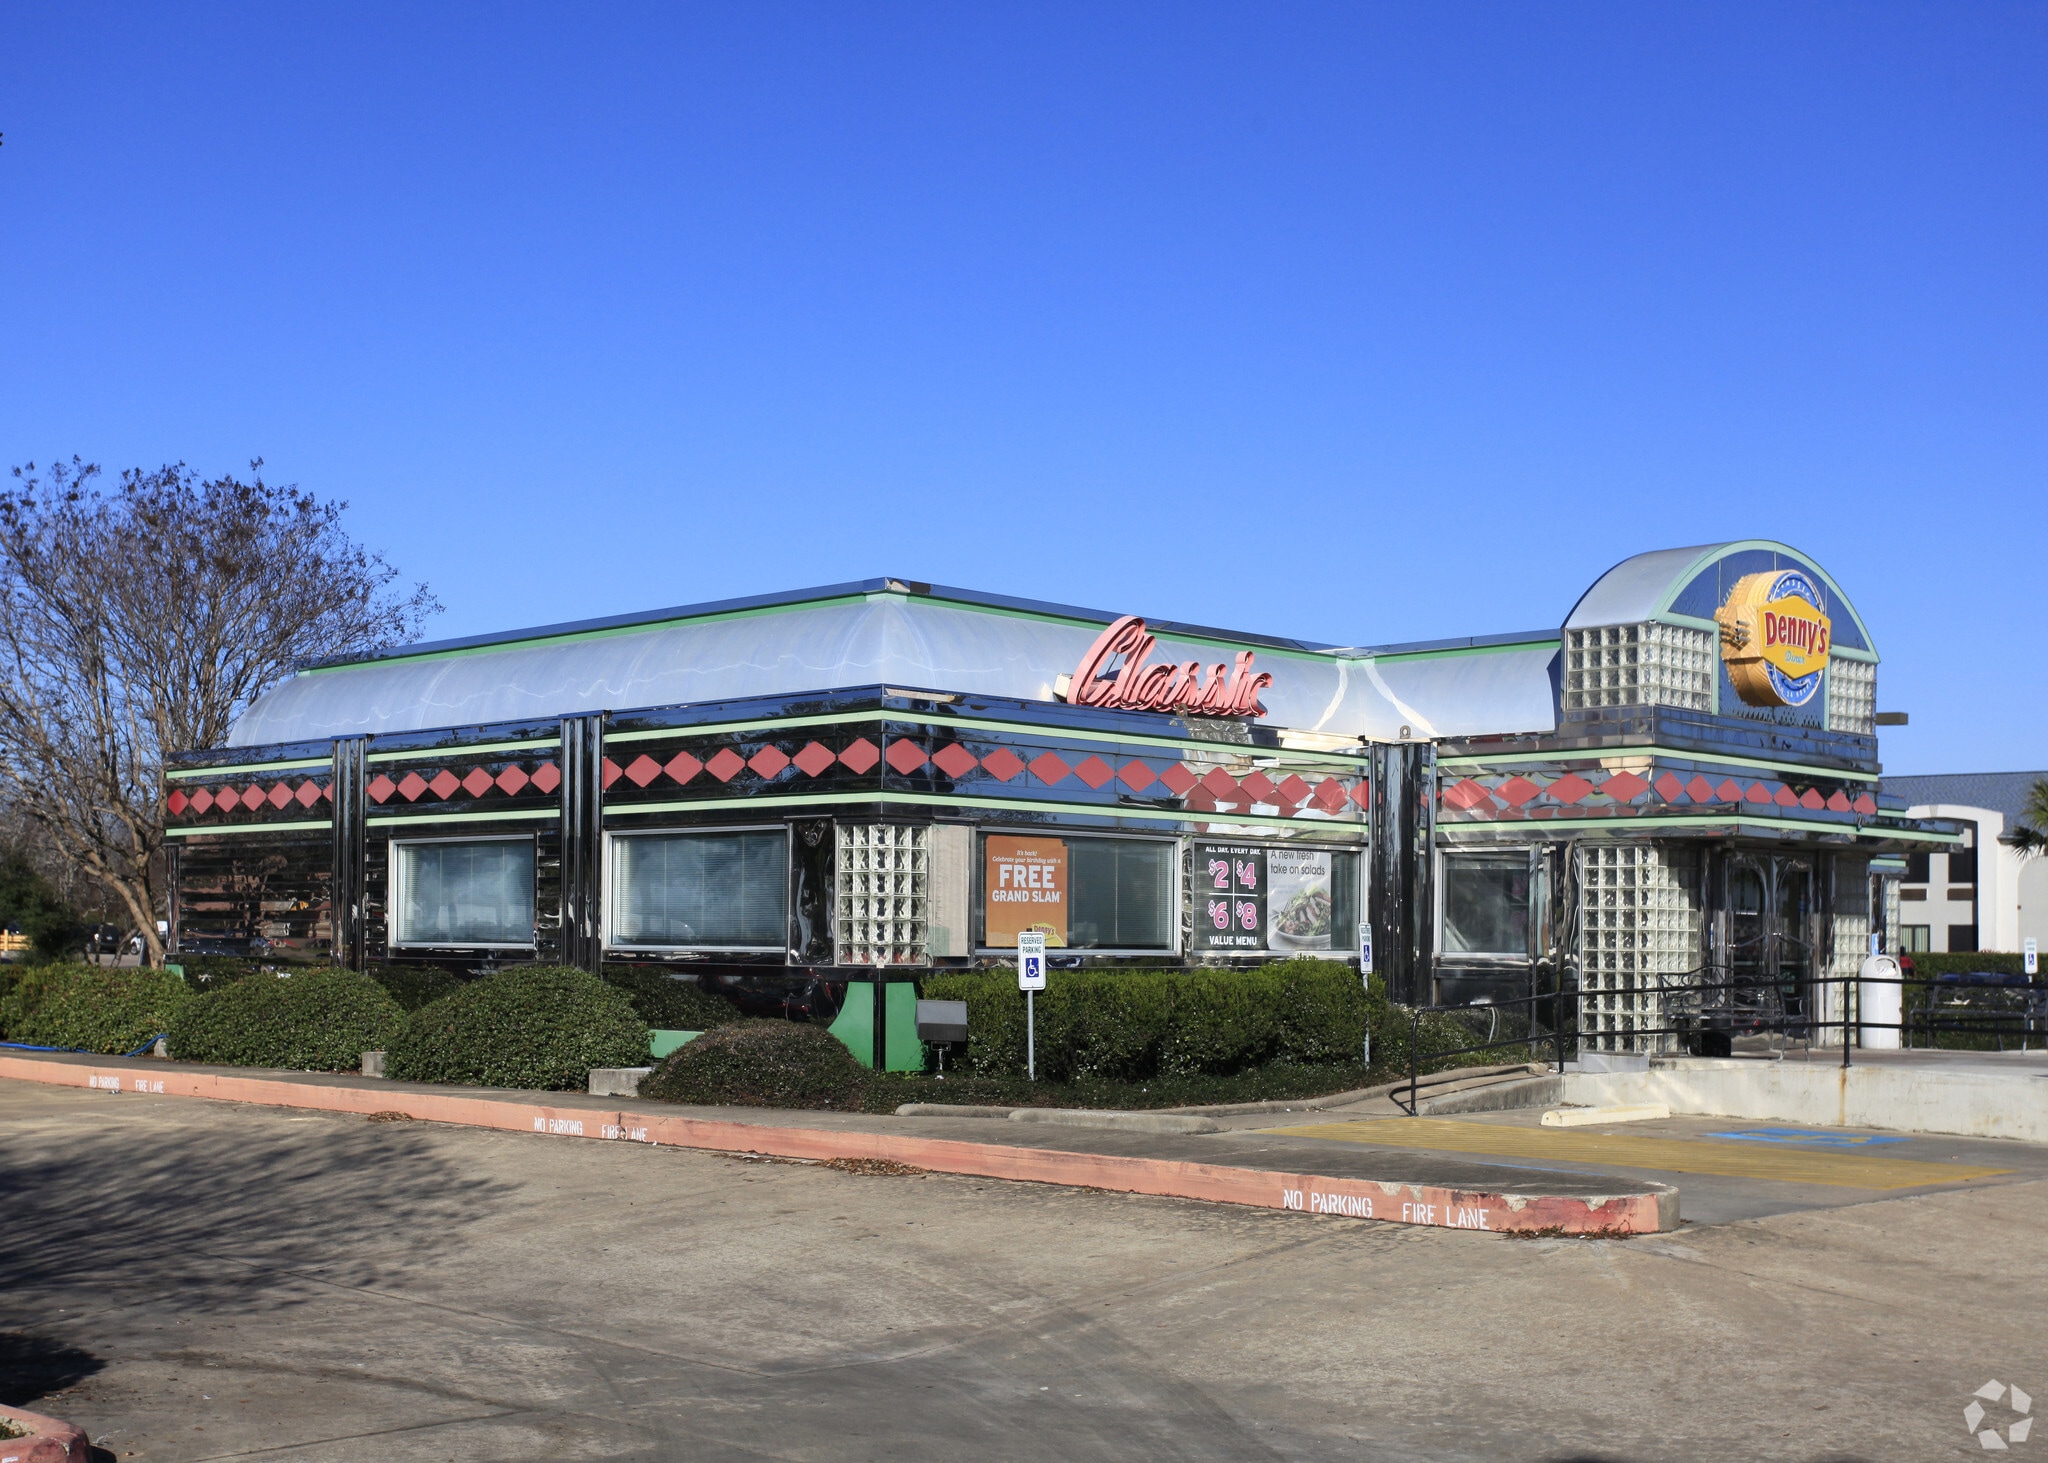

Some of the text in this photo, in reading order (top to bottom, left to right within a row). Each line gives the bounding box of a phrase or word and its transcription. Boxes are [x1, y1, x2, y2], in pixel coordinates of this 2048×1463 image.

[1765, 611, 1827, 656] Denny's
[1067, 614, 1273, 719] Classic
[1271, 850, 1277, 859] A
[1279, 851, 1294, 860] new
[1000, 864, 1054, 888] FREE
[1209, 859, 1229, 888] $2
[1236, 860, 1257, 889] $4
[1271, 864, 1326, 876] take on salads
[992, 890, 1029, 902] GRAND
[1208, 900, 1257, 930] $6 $8
[1021, 936, 1042, 945] RESERVED
[1022, 946, 1041, 954] PARKING
[1209, 936, 1257, 946] VALUE MENU
[98, 1076, 120, 1089] PARKING
[135, 1079, 148, 1093] FIRE
[149, 1080, 164, 1093] LANE
[534, 1117, 545, 1132] NO
[549, 1119, 583, 1136] PARKING
[601, 1124, 620, 1139] FIRE
[1284, 1190, 1490, 1230] NO PARKING FIRE LANE
